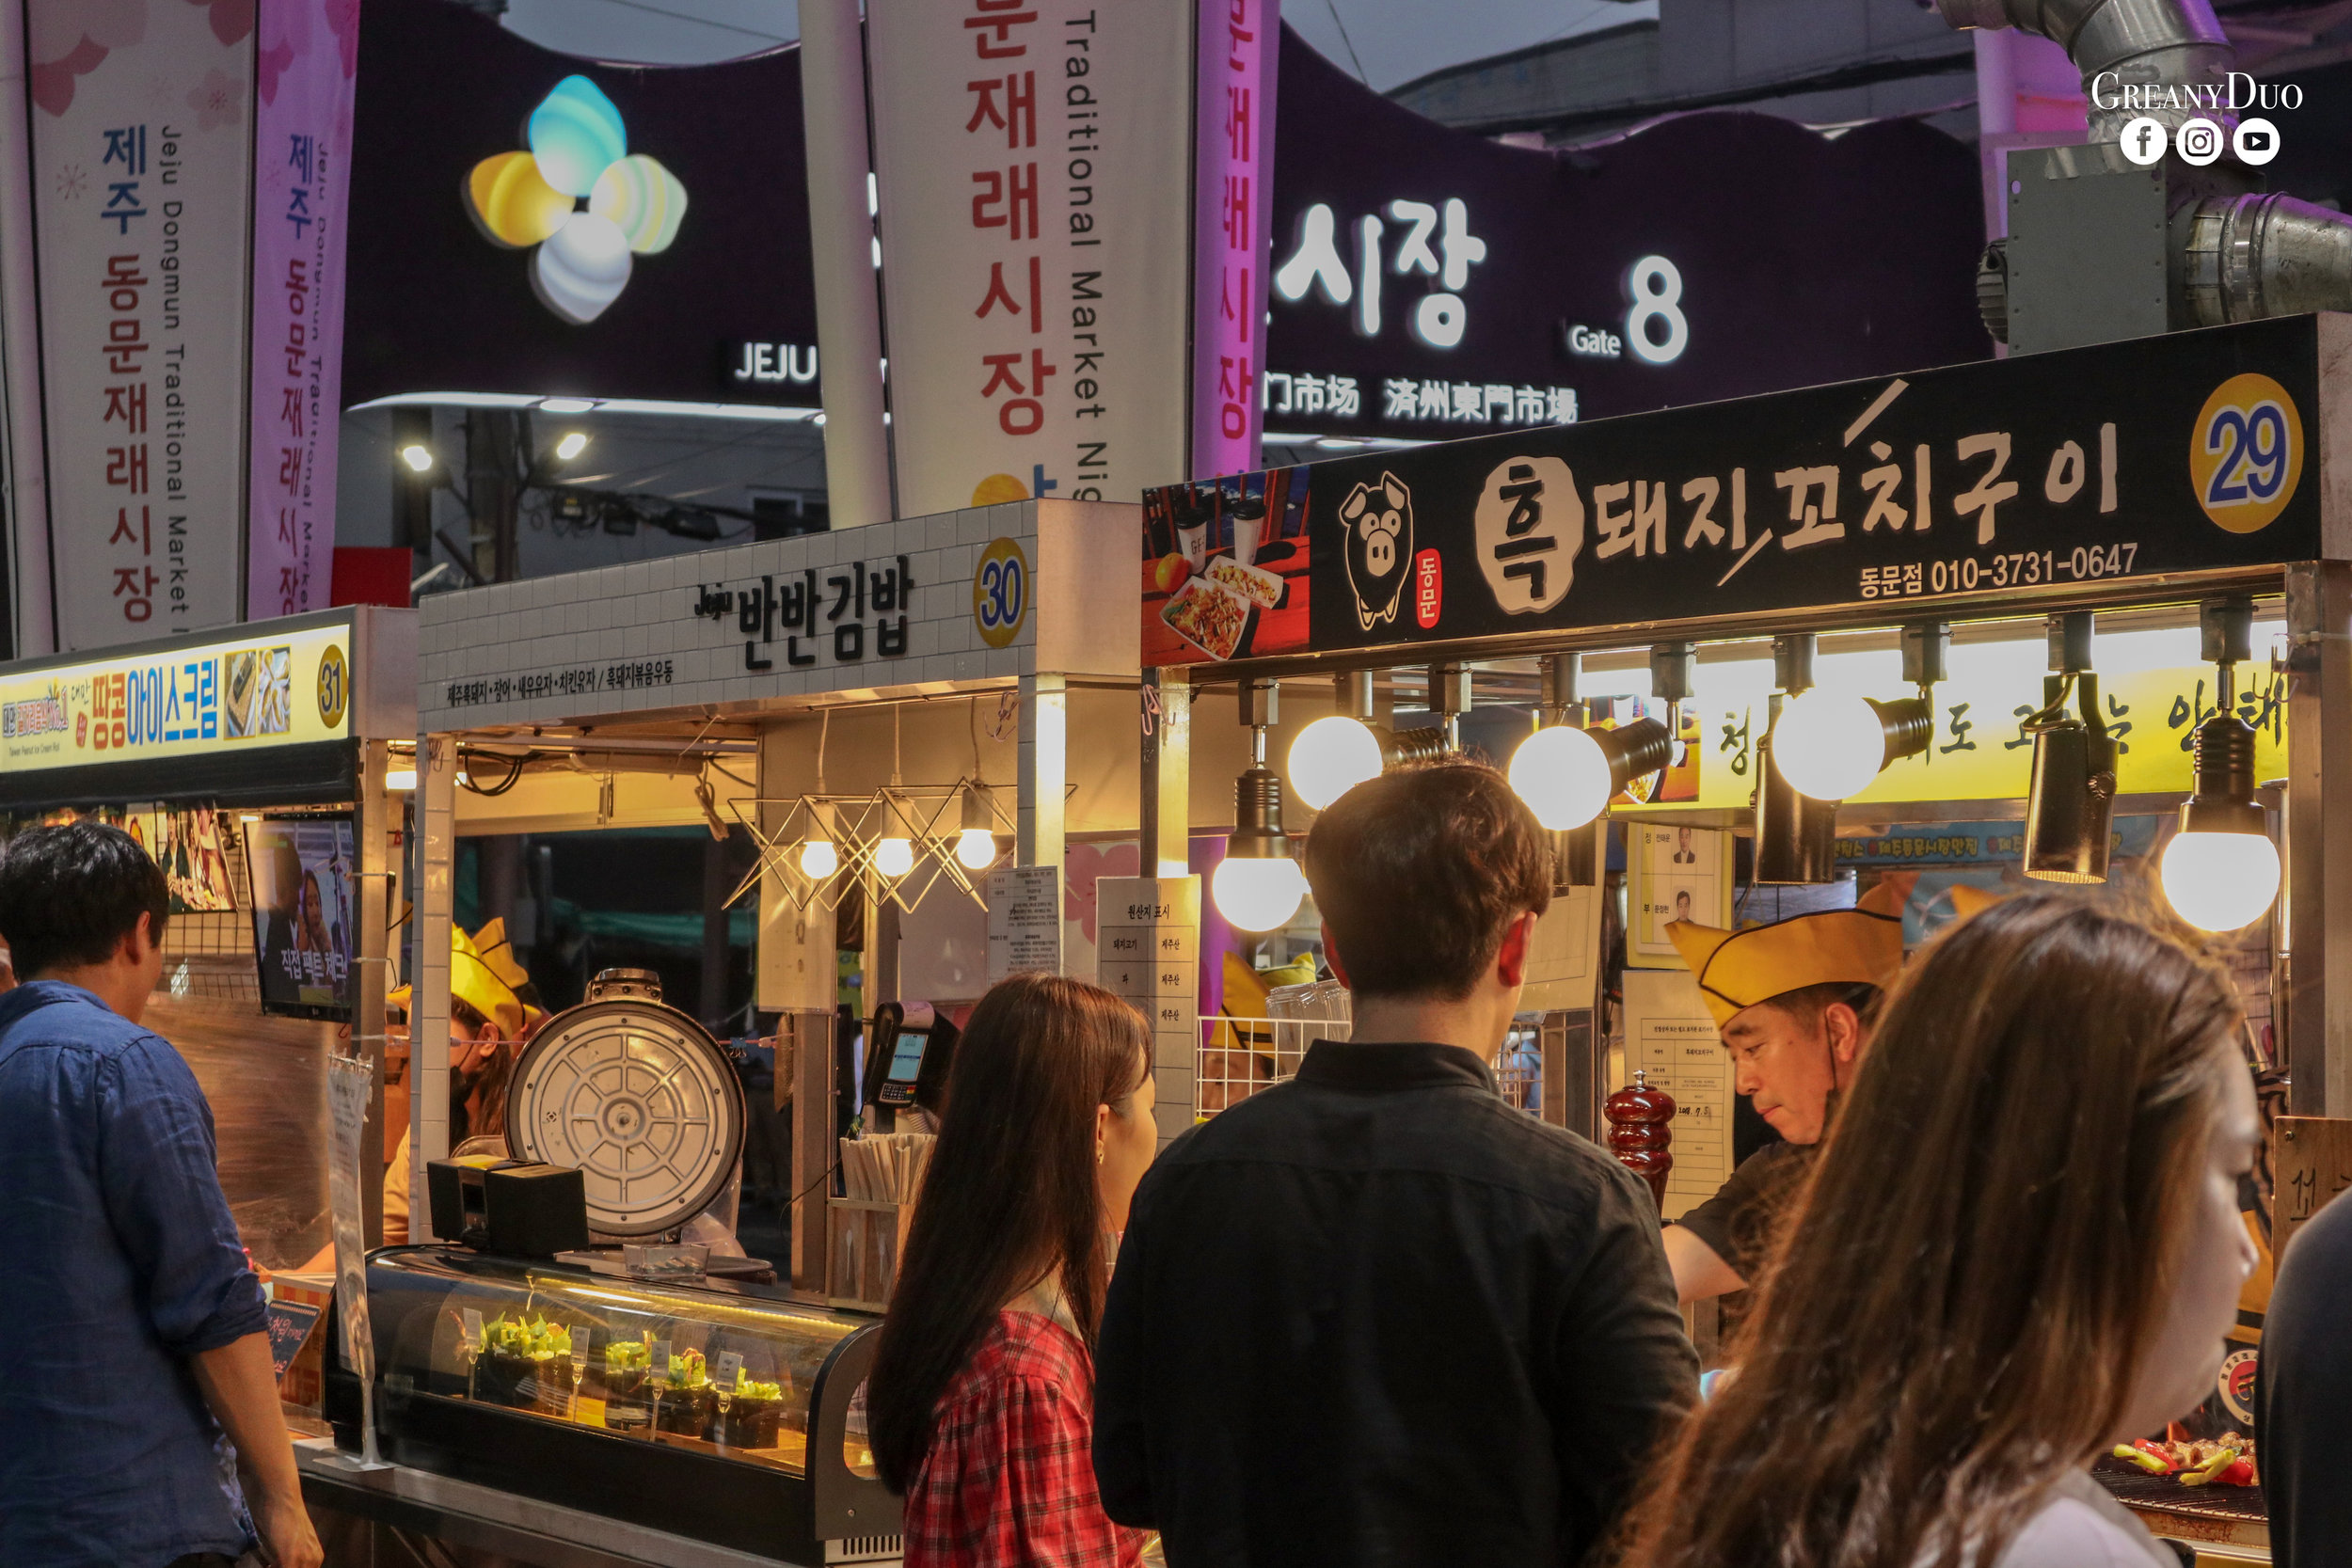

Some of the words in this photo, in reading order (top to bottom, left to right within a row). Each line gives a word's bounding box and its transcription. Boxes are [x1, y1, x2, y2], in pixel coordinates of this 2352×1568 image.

[162, 126, 178, 186] Jeju
[316, 142, 328, 200] Jeju
[1065, 10, 1101, 246] Traditional
[101, 124, 148, 236] 제주
[286, 134, 313, 239] 제주
[161, 200, 183, 330] Dongmun
[1278, 198, 1486, 347] 시장
[1572, 325, 1622, 357] Gate
[1628, 256, 1689, 363] 8
[736, 341, 817, 381] JEJU
[1072, 271, 1106, 419] Market
[165, 344, 186, 502] Traditional
[303, 356, 323, 507] Traditional
[2208, 404, 2288, 504] 29
[167, 515, 188, 614] Market
[739, 554, 914, 670] 반반김밥
[980, 560, 1022, 626] 30
[1420, 557, 1437, 618] 동문
[1859, 567, 1923, 598] 동문점
[1931, 543, 2138, 593] 010-3731-0647
[92, 673, 126, 751] 땅콩
[127, 658, 218, 746] 아이스크림
[321, 661, 342, 714] 31
[1128, 904, 1152, 920] 원산지
[1153, 904, 1170, 920] 표시
[281, 948, 302, 979] 직접
[302, 949, 325, 980] 팩트
